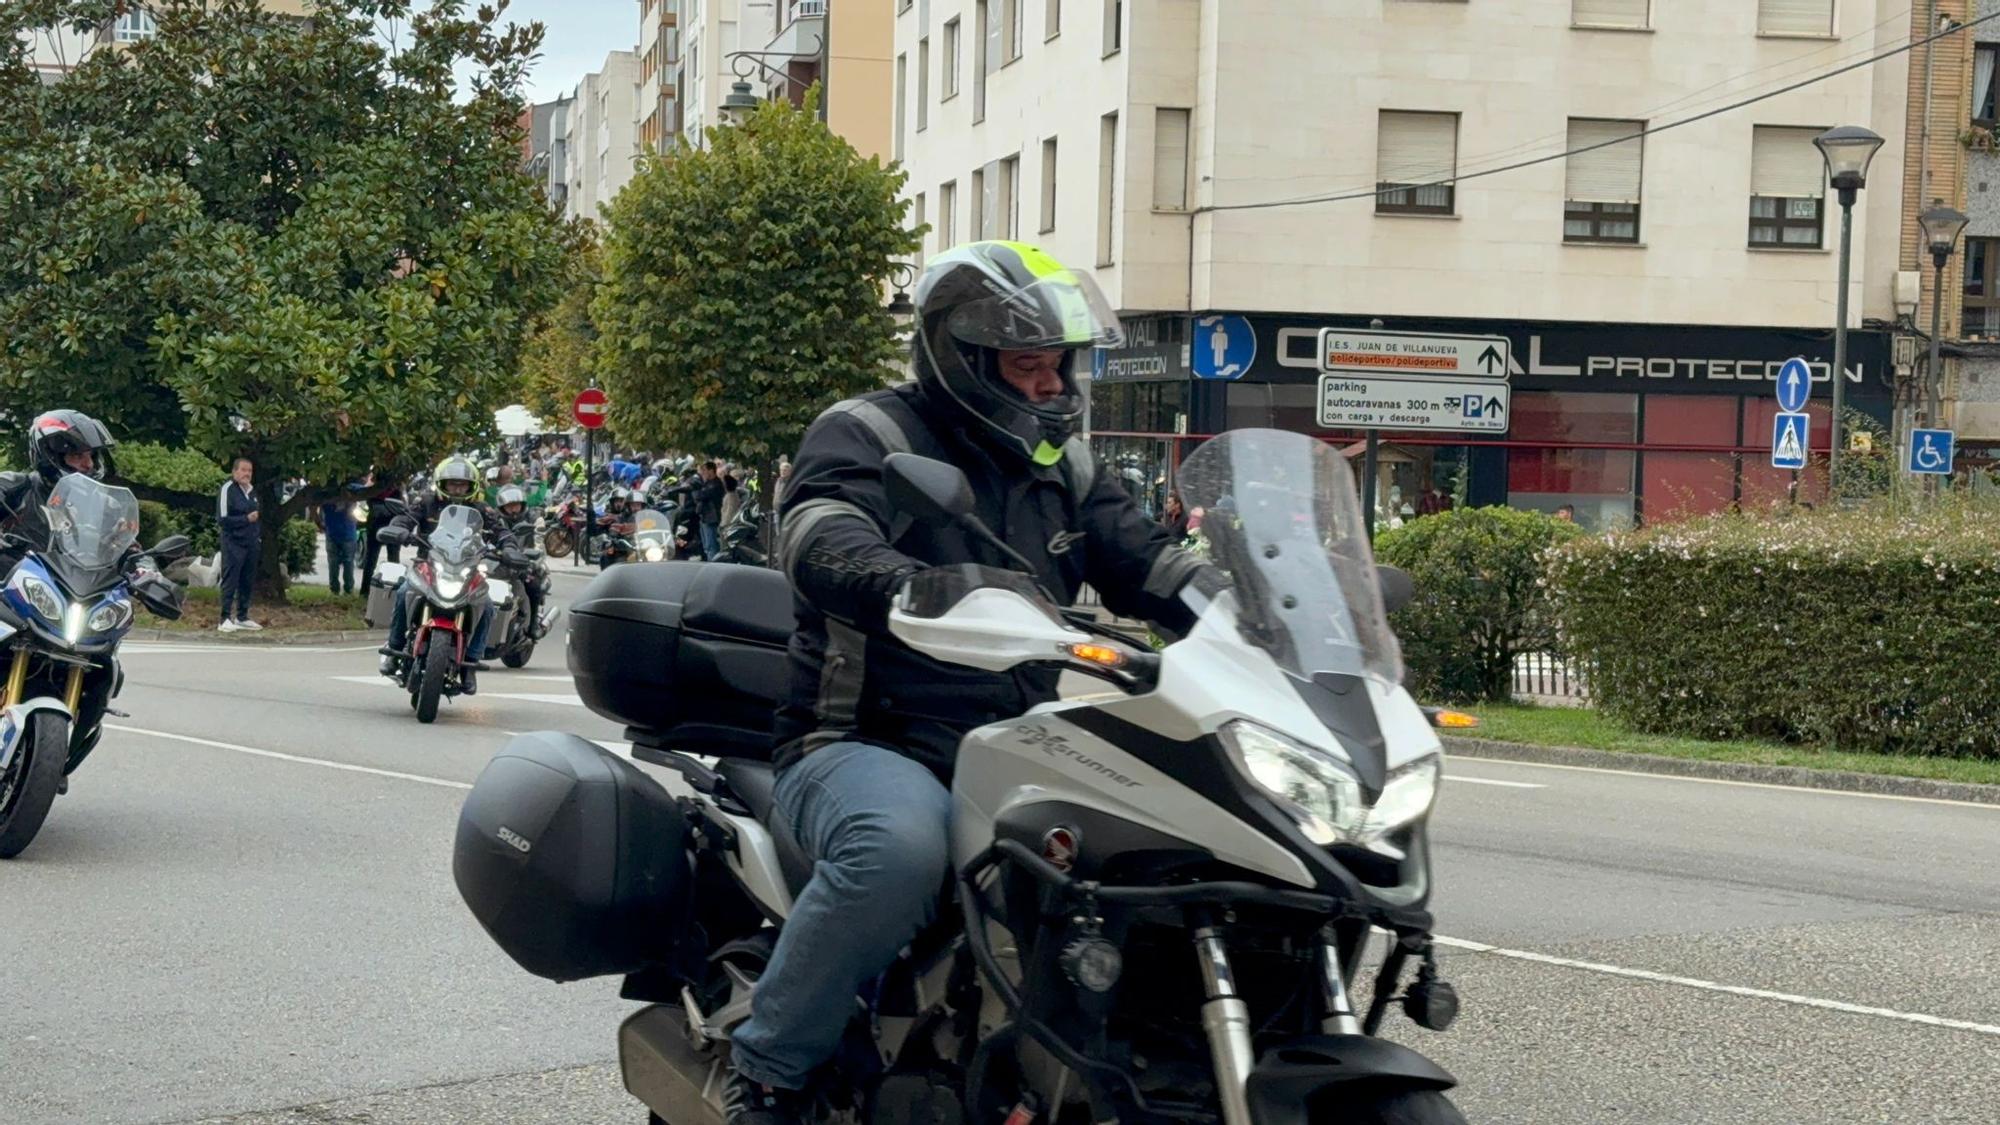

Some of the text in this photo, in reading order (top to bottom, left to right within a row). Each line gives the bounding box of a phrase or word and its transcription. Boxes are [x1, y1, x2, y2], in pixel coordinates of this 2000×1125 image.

[1356, 342, 1381, 351] JUAN
[1386, 343, 1398, 352] DE
[1402, 344, 1458, 354] VILLANUEVA
[1587, 355, 1863, 383] PROTECCÓN
[1326, 382, 1367, 394] parking
[1326, 398, 1401, 410] autocaravanas
[1406, 400, 1428, 410] 300
[1326, 412, 1343, 420] con
[1348, 413, 1374, 422] carga
[1389, 413, 1431, 424] descarga
